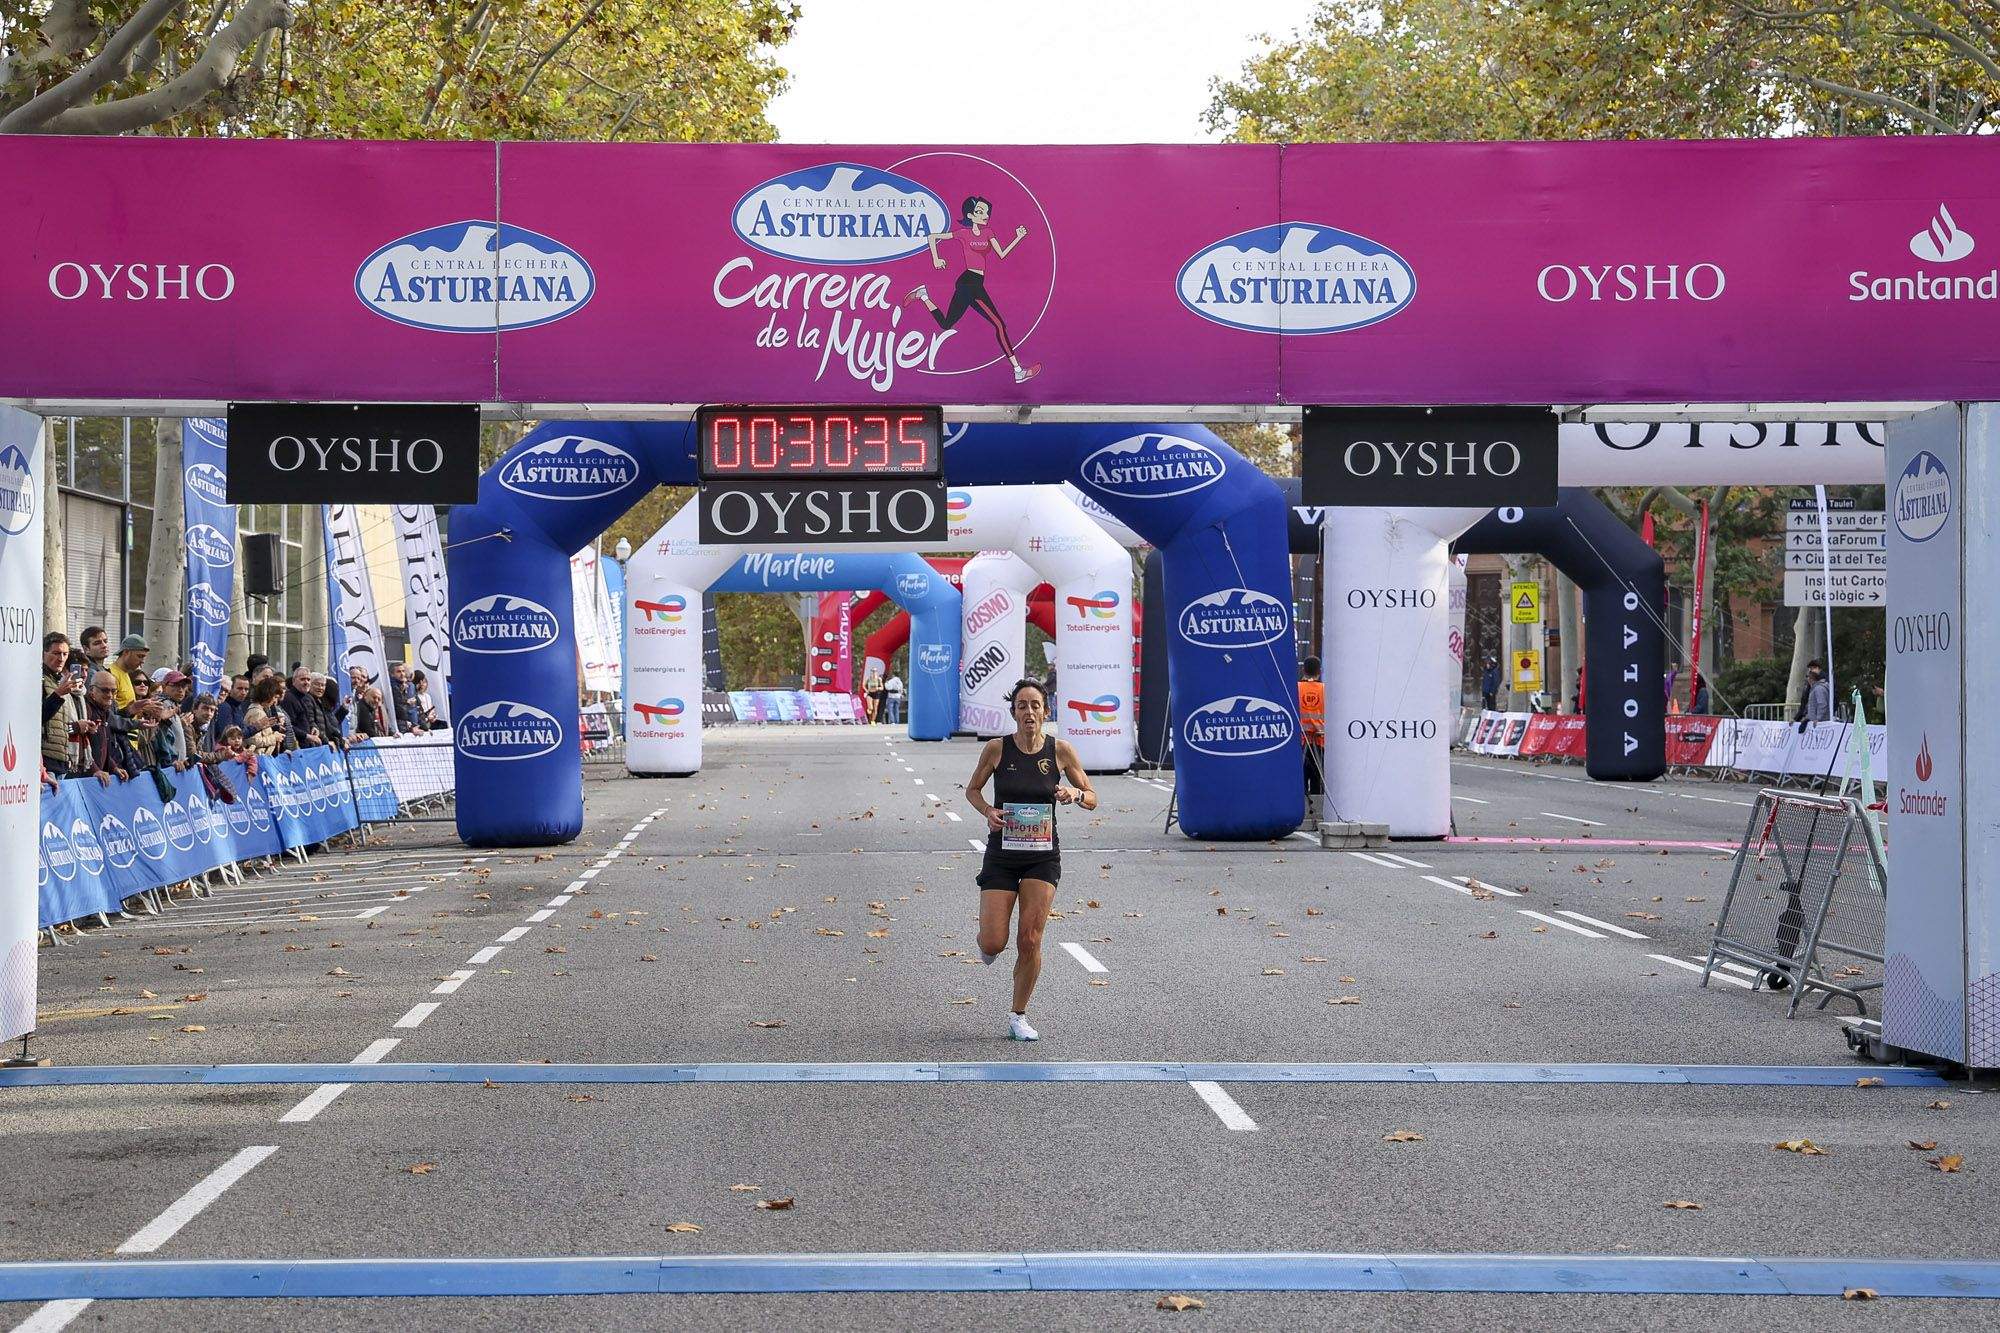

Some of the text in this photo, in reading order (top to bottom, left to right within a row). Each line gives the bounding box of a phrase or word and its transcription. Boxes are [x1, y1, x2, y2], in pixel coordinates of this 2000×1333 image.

[782, 198, 927, 209] CENTRAL LECHERA
[748, 200, 931, 238] ASTURIANA
[411, 259, 569, 270] CENTRAL LECHERA
[1232, 261, 1389, 272] CENTRAL LECHERA
[48, 262, 235, 301] OYSHO
[374, 261, 577, 303] ASTURIANA
[712, 256, 891, 311] Carrera
[1195, 263, 1398, 304] ASTURIANA
[1536, 263, 1726, 302] OYSHO
[756, 305, 958, 393] de la Mujer
[714, 416, 926, 468] 00:30:35
[268, 435, 444, 474] OYSHO
[530, 457, 625, 465] CENTRAL LECHERA
[1110, 452, 1209, 466] CENTRAL LECHERA
[1343, 441, 1521, 476] OYSHO
[507, 461, 628, 484] ASTURIANA
[1093, 461, 1217, 484] ASTURIANA
[711, 489, 935, 536] OYSHO
[1791, 500, 1804, 508] Av.
[1829, 500, 1854, 508] Taulet
[1898, 489, 1948, 522] ASTURIANA
[1807, 514, 1878, 525] Mis van der
[1806, 534, 1878, 545] CaxaForum
[743, 552, 835, 587] Marlene
[1805, 553, 1841, 565] Ciuat
[1845, 553, 1863, 565] del
[1347, 588, 1436, 609] OYSHO
[1804, 590, 1808, 600] i
[468, 614, 549, 622] CENTRAL LECHERA
[966, 592, 1010, 634] COSMO
[1201, 606, 1280, 617] CENTRAL LECHERA
[457, 618, 552, 642] ASTURIANA
[634, 627, 686, 636] TotalEnergies
[1066, 623, 1120, 633] TotalEnergies
[1185, 612, 1284, 635] ASTURIANA
[1894, 611, 1950, 654] OYSHO
[633, 666, 685, 674] totalenergies.es
[964, 646, 1005, 690] COSMO
[1066, 662, 1120, 671] totalenergies.es
[1623, 591, 1639, 757] VOLVO
[472, 720, 552, 729] CENTRAL LECHERA
[1205, 714, 1286, 724] CENTRAL LECHERA
[1347, 719, 1437, 740] OYSHO
[460, 725, 556, 747] ASTURIANA
[633, 730, 685, 740] TotalEnergies
[1067, 727, 1121, 737] TotalEnergies
[1190, 719, 1289, 742] ASTURIANA
[1900, 788, 1947, 817] Santander
